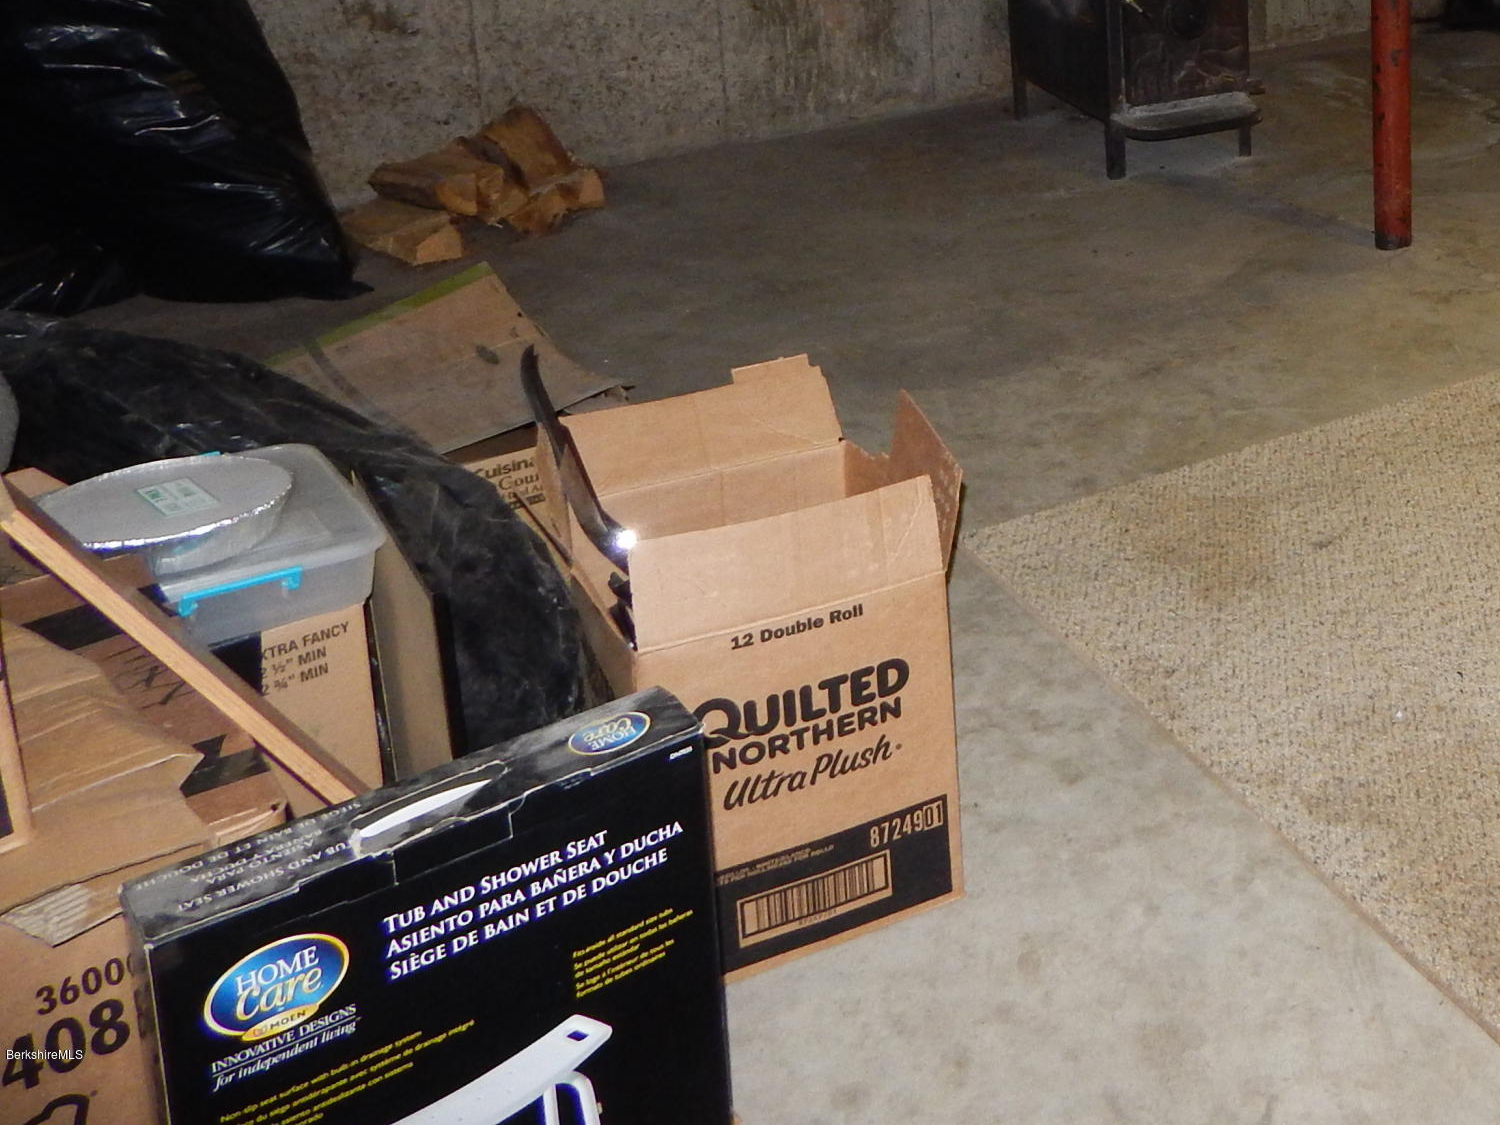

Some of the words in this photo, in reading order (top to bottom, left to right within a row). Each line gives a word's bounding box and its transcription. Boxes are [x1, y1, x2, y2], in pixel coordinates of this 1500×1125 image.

[302, 621, 349, 647] FANCY
[731, 632, 754, 650] 12
[760, 617, 824, 643] Double
[829, 603, 864, 624] Roll
[298, 646, 327, 666] MIN
[300, 662, 329, 683] MIN
[693, 658, 910, 750] QUILTED
[588, 726, 637, 750] HOME
[712, 696, 902, 774] NORTHERN
[723, 770, 806, 811] Ultra
[809, 734, 892, 786] Plush
[216, 867, 284, 897] SHOWER
[288, 850, 321, 869] AND
[383, 906, 425, 933] TUB
[430, 885, 476, 917] AND
[479, 850, 562, 895] SHOWER
[566, 830, 607, 860] SEAT
[179, 893, 212, 912] SEAT
[386, 910, 474, 958] ASIENTO
[478, 889, 526, 919] PARA
[529, 858, 601, 897] BAÑERA
[603, 848, 618, 865] Y
[620, 821, 683, 858] DUCHA
[390, 942, 447, 980] SIÈGE
[452, 931, 479, 955] DE
[484, 908, 530, 940] BAIN
[535, 896, 557, 919] ET
[562, 885, 587, 907] DE
[591, 847, 668, 894] DOUCHE
[35, 953, 134, 1015] 3600
[236, 946, 319, 995] HOME
[211, 1029, 296, 1073] INNOVATIVE
[299, 1003, 357, 1037] DESIGNS
[270, 1010, 307, 1031] MOEN
[212, 1071, 236, 1092] for
[238, 1036, 318, 1079] independent
[321, 1022, 358, 1044] living
[360, 1043, 393, 1062] drainage
[395, 1031, 422, 1047] system
